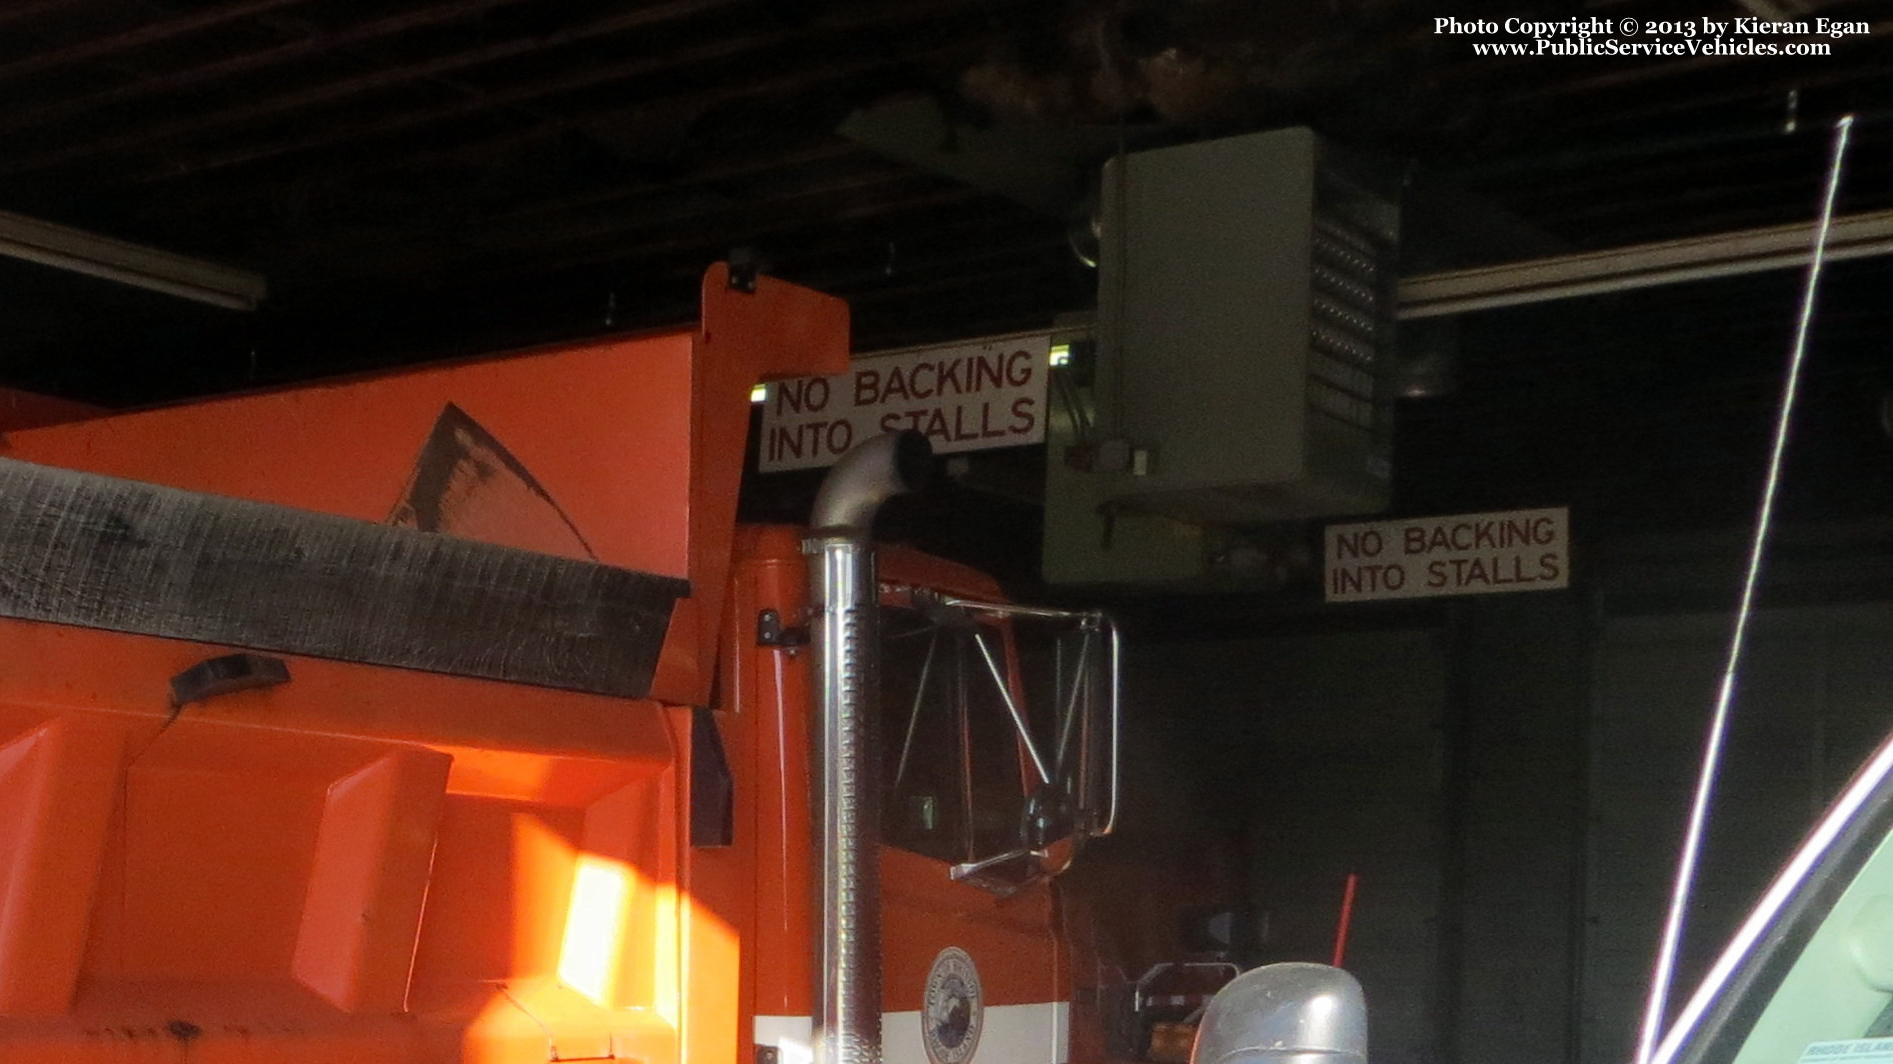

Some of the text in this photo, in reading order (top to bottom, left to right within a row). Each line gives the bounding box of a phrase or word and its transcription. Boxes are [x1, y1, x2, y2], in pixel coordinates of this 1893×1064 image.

[776, 350, 1033, 417] NO BACKING
[767, 419, 853, 462] INTO
[1336, 517, 1556, 559] NO BACKING
[1332, 553, 1560, 594] INTO STALLS
